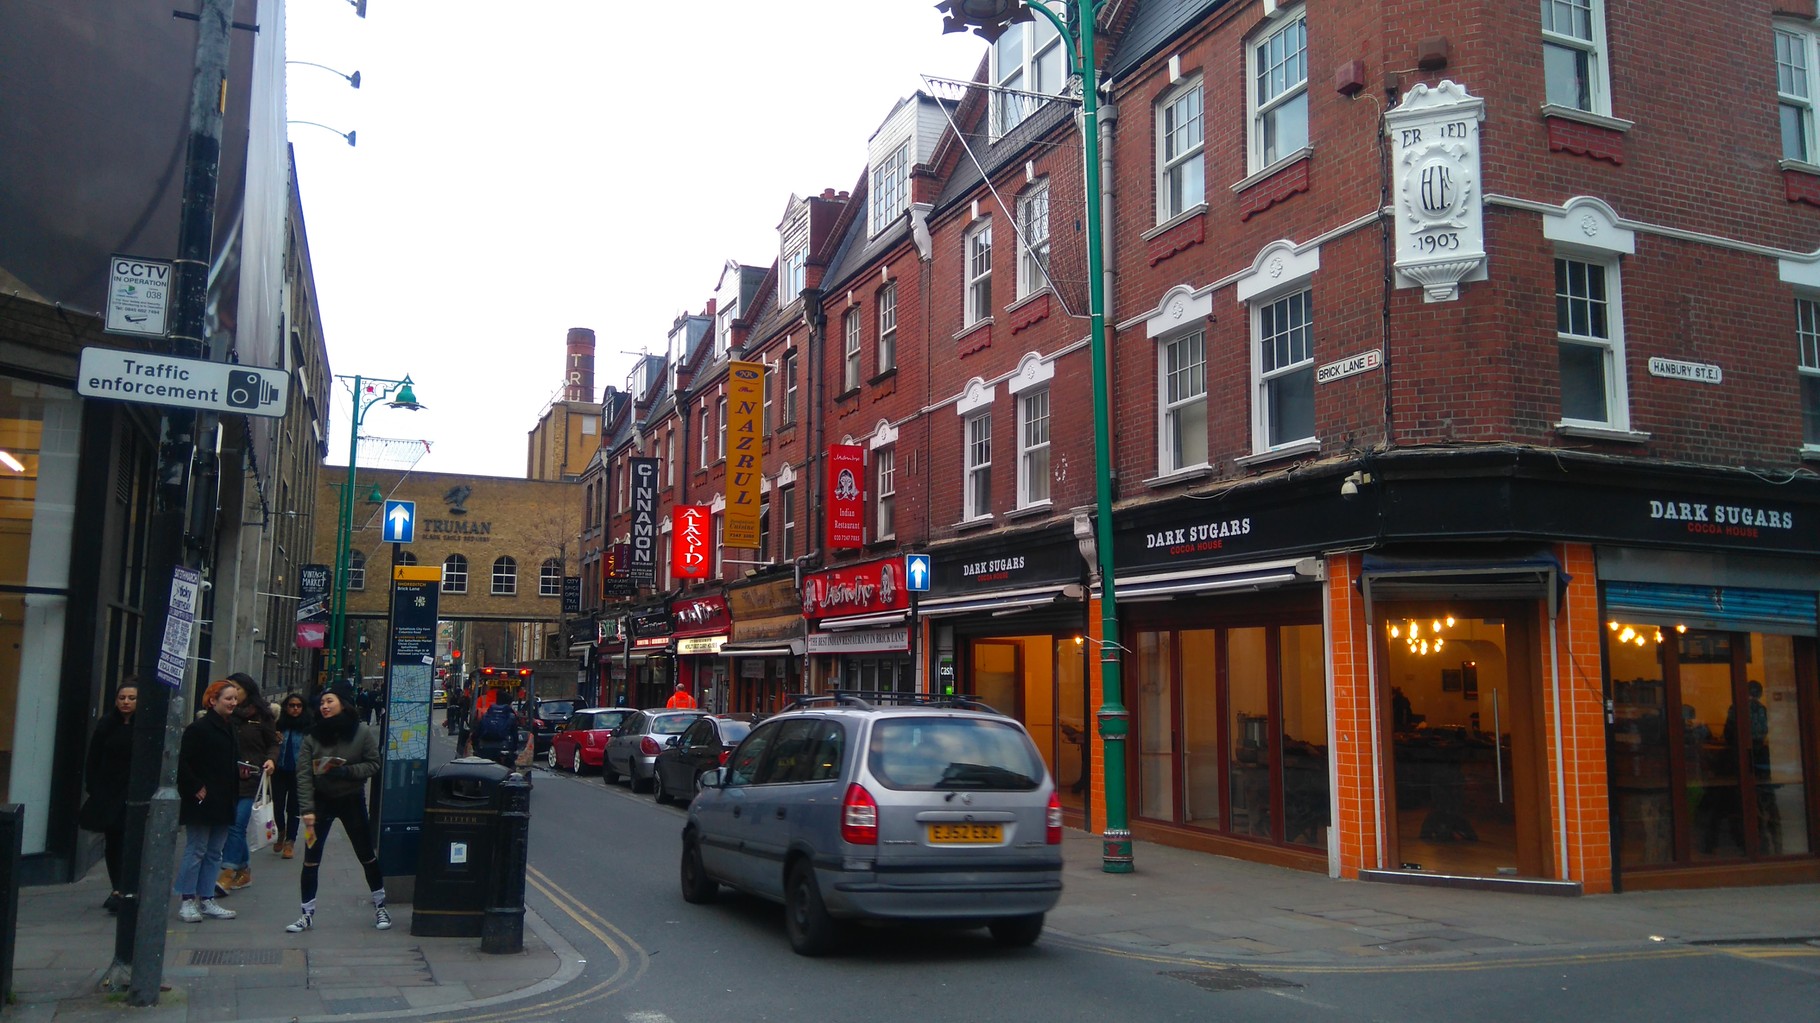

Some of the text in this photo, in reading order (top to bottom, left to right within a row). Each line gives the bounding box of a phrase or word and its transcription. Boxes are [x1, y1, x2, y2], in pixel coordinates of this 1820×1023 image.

[116, 262, 168, 279] CCTV
[123, 277, 167, 287] OPERATION
[146, 291, 162, 299] 038
[123, 359, 190, 381] Traffic
[1318, 354, 1378, 380] BRICK LANE E1
[1654, 361, 1692, 376] HANBURY
[89, 377, 218, 402] enforcement
[734, 401, 758, 505] NAZRUL
[634, 464, 652, 562] CINNAMON
[840, 508, 855, 517] Indian
[1650, 500, 1793, 529] DARK SUGARS
[423, 520, 492, 535] TRUMAN
[834, 520, 860, 530] Restaurant
[1687, 522, 1759, 538] COCOA HOUSE
[1147, 518, 1250, 549] DARK SUGARS
[1170, 540, 1223, 555] COCOA HOUSE
[964, 556, 1025, 576] DARK SUGARS
[302, 570, 326, 580] VINTAGE
[302, 578, 326, 587] MARKET
[840, 634, 867, 646] RESTAURANT
[876, 632, 890, 644] BRICK
[940, 664, 954, 676] cash
